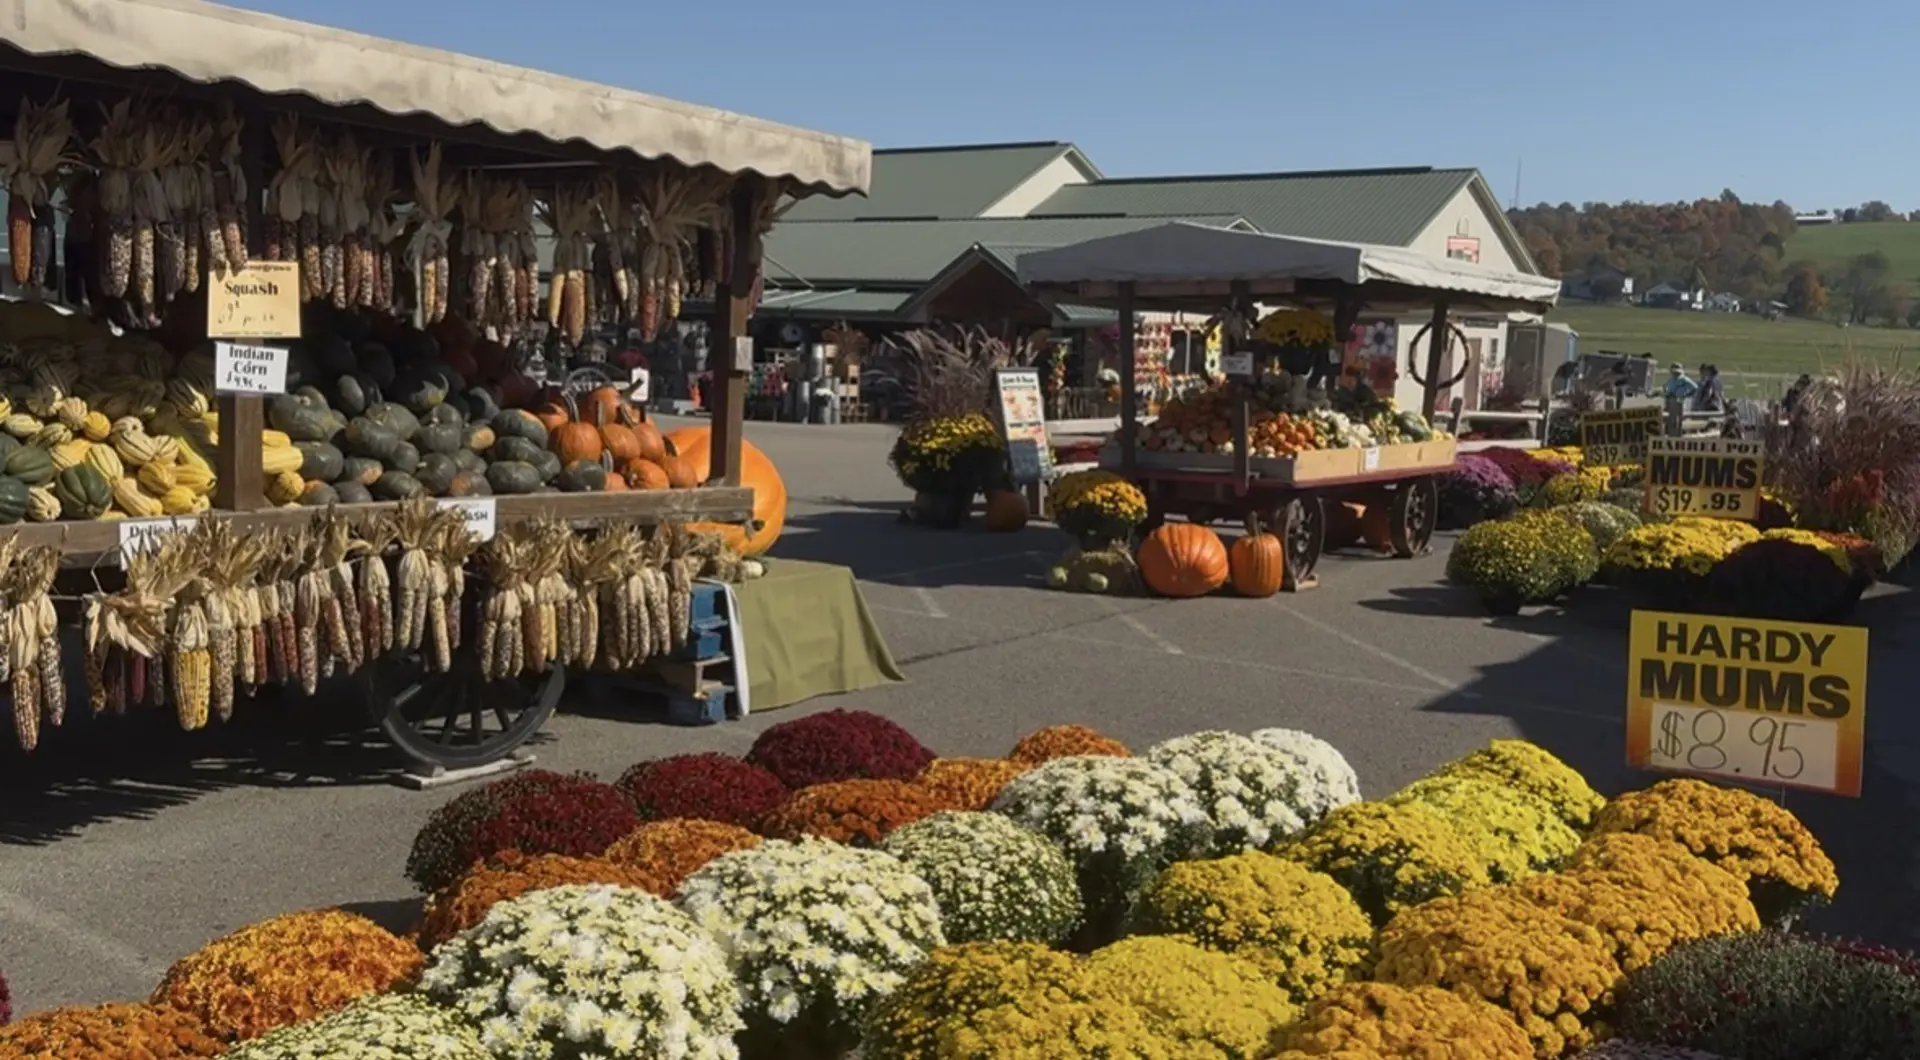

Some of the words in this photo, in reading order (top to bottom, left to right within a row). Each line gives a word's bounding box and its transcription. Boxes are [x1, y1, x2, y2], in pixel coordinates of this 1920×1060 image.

[224, 281, 279, 297] Squash
[229, 345, 275, 361] Indian
[233, 360, 267, 376] Corn
[1585, 420, 1661, 445] MUMS
[1651, 439, 1718, 453] BARREL
[1725, 442, 1760, 455] POT
[1651, 455, 1758, 489] MUMS
[1656, 621, 1836, 668] HARDY
[1640, 658, 1851, 719] MUMS
[1657, 709, 1807, 779] $8.95
